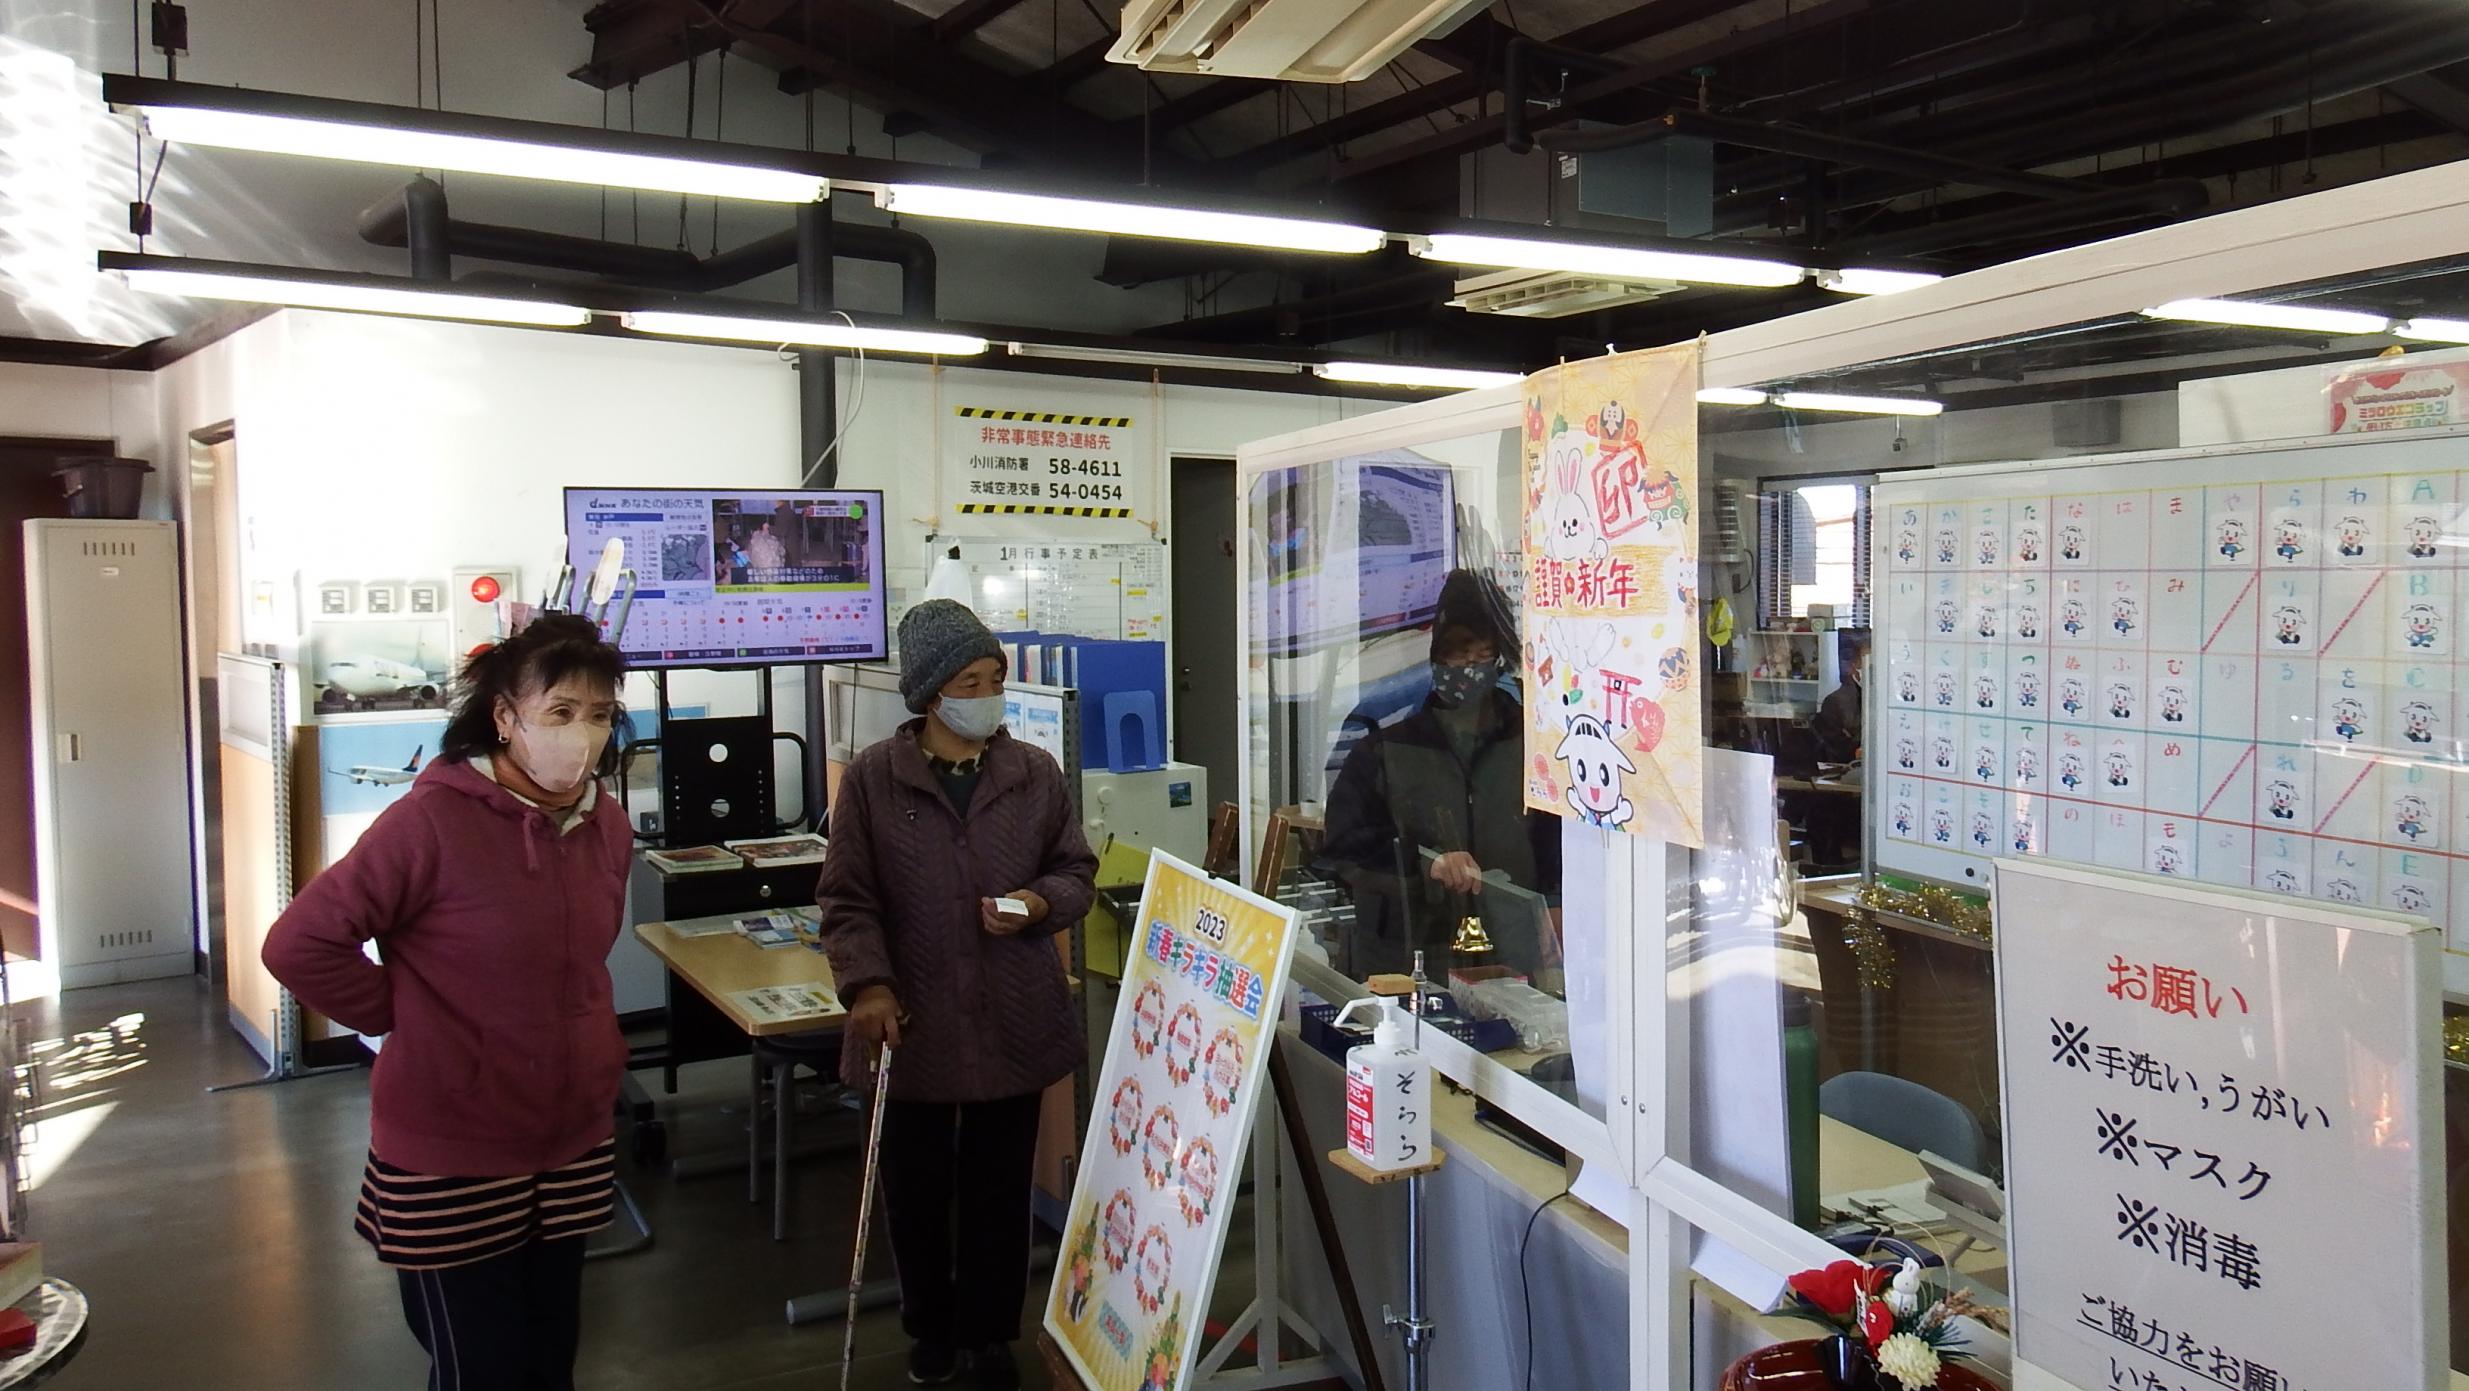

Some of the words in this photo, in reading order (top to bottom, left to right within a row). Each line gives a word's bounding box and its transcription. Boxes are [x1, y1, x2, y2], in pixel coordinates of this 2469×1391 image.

[981, 426, 1112, 451] 非常事態緊急連絡先
[970, 455, 1029, 472] 小川消防署
[1049, 458, 1122, 477] 58-4611
[970, 480, 1041, 497] 茨城空港交番
[1049, 482, 1122, 500] 54-0454
[2024, 505, 2036, 520] た
[2170, 497, 2182, 515] ま
[2412, 479, 2435, 501] A
[2167, 578, 2185, 592] み
[2409, 574, 2429, 596] B
[2022, 654, 2035, 665] つ
[2167, 659, 2183, 675] む
[2406, 667, 2426, 688] C
[2020, 726, 2034, 742] て
[2164, 742, 2181, 757] め
[2064, 808, 2079, 822] の
[2402, 854, 2420, 877] E
[1195, 909, 1226, 942] 2023
[1147, 920, 1263, 1019] 新春キラキラ抽選会
[2106, 955, 2249, 1019] お願い
[1396, 1070, 1418, 1162] そらら
[2081, 1292, 2301, 1391] ご協力をお願
